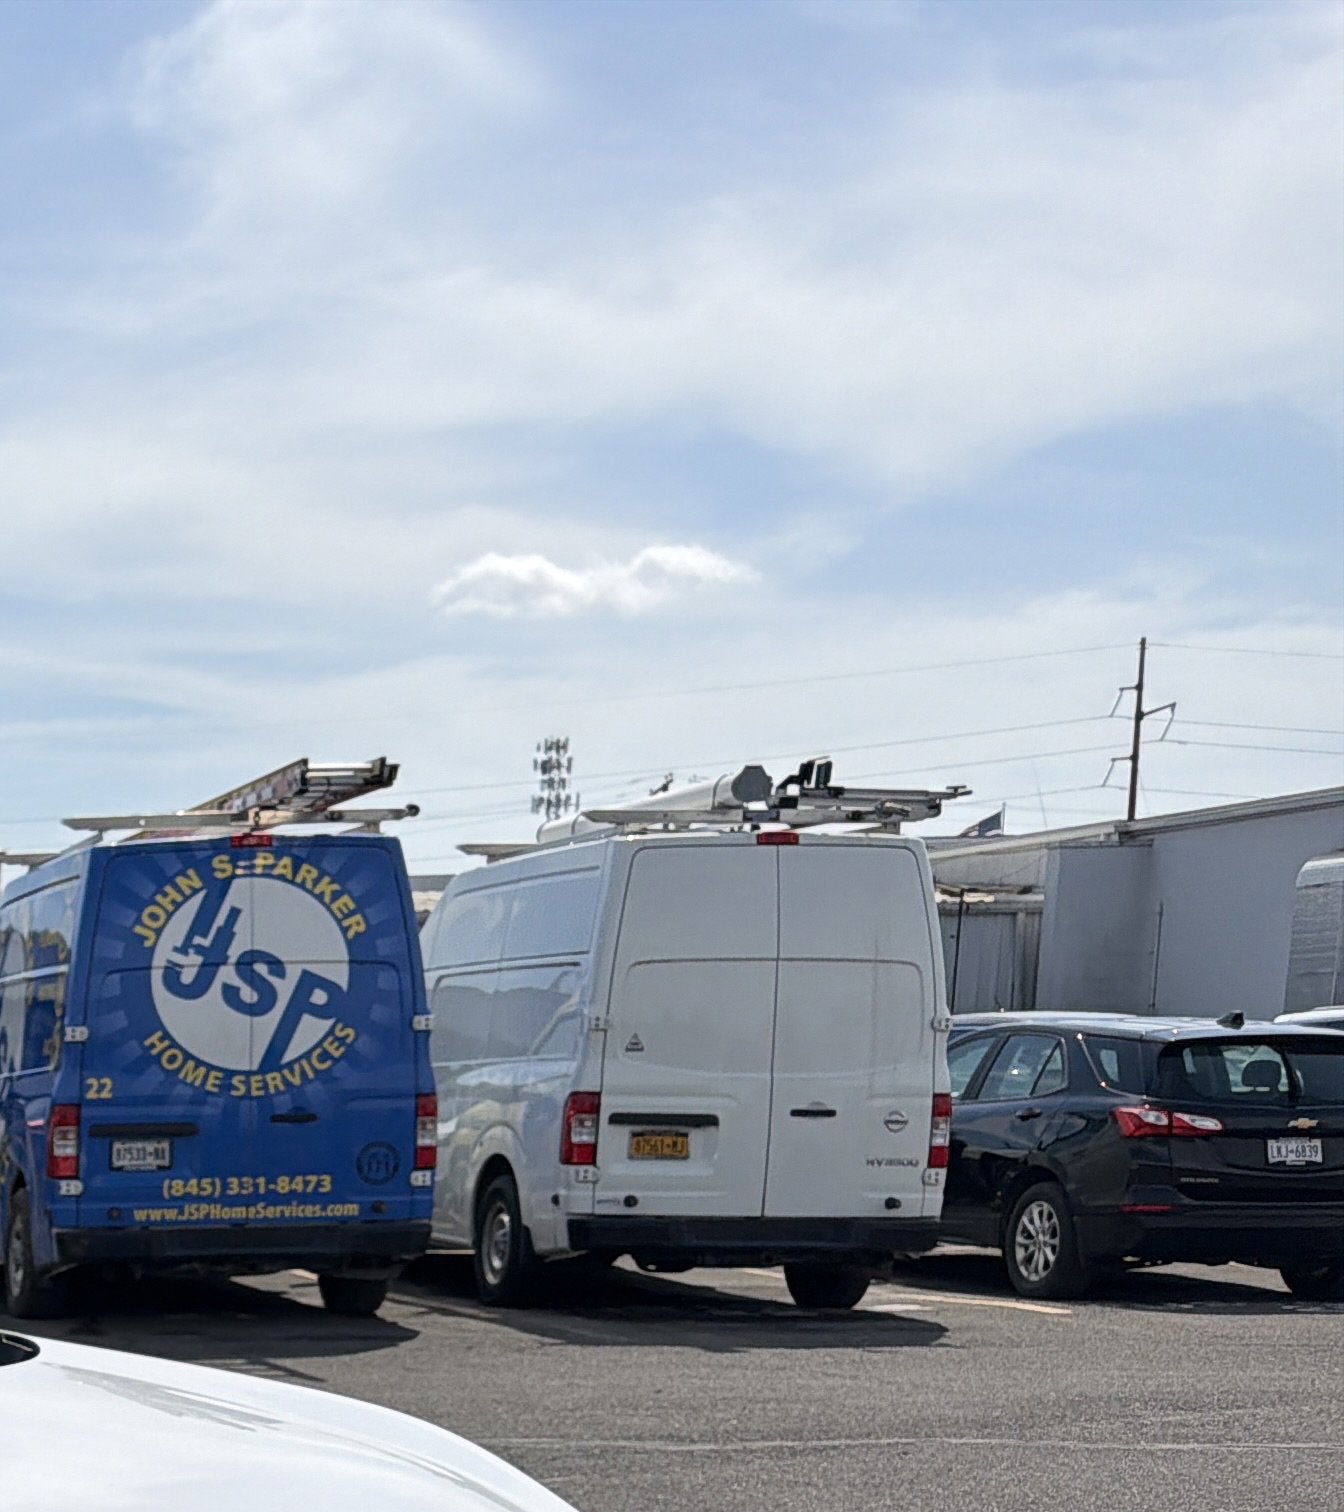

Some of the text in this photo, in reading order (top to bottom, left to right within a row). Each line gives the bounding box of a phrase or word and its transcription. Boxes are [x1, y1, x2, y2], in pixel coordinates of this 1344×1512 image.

[132, 868, 205, 948] JOHN
[255, 852, 367, 939] PARKER
[162, 888, 352, 1071] JSP
[143, 1023, 357, 1097] HOME SERVICES
[86, 1077, 113, 1100] 22
[1270, 1144, 1319, 1159] LKJ-6839
[163, 1174, 332, 1199] (845) 331-8473
[133, 1201, 360, 1222] www.JSPHomeServices.com
